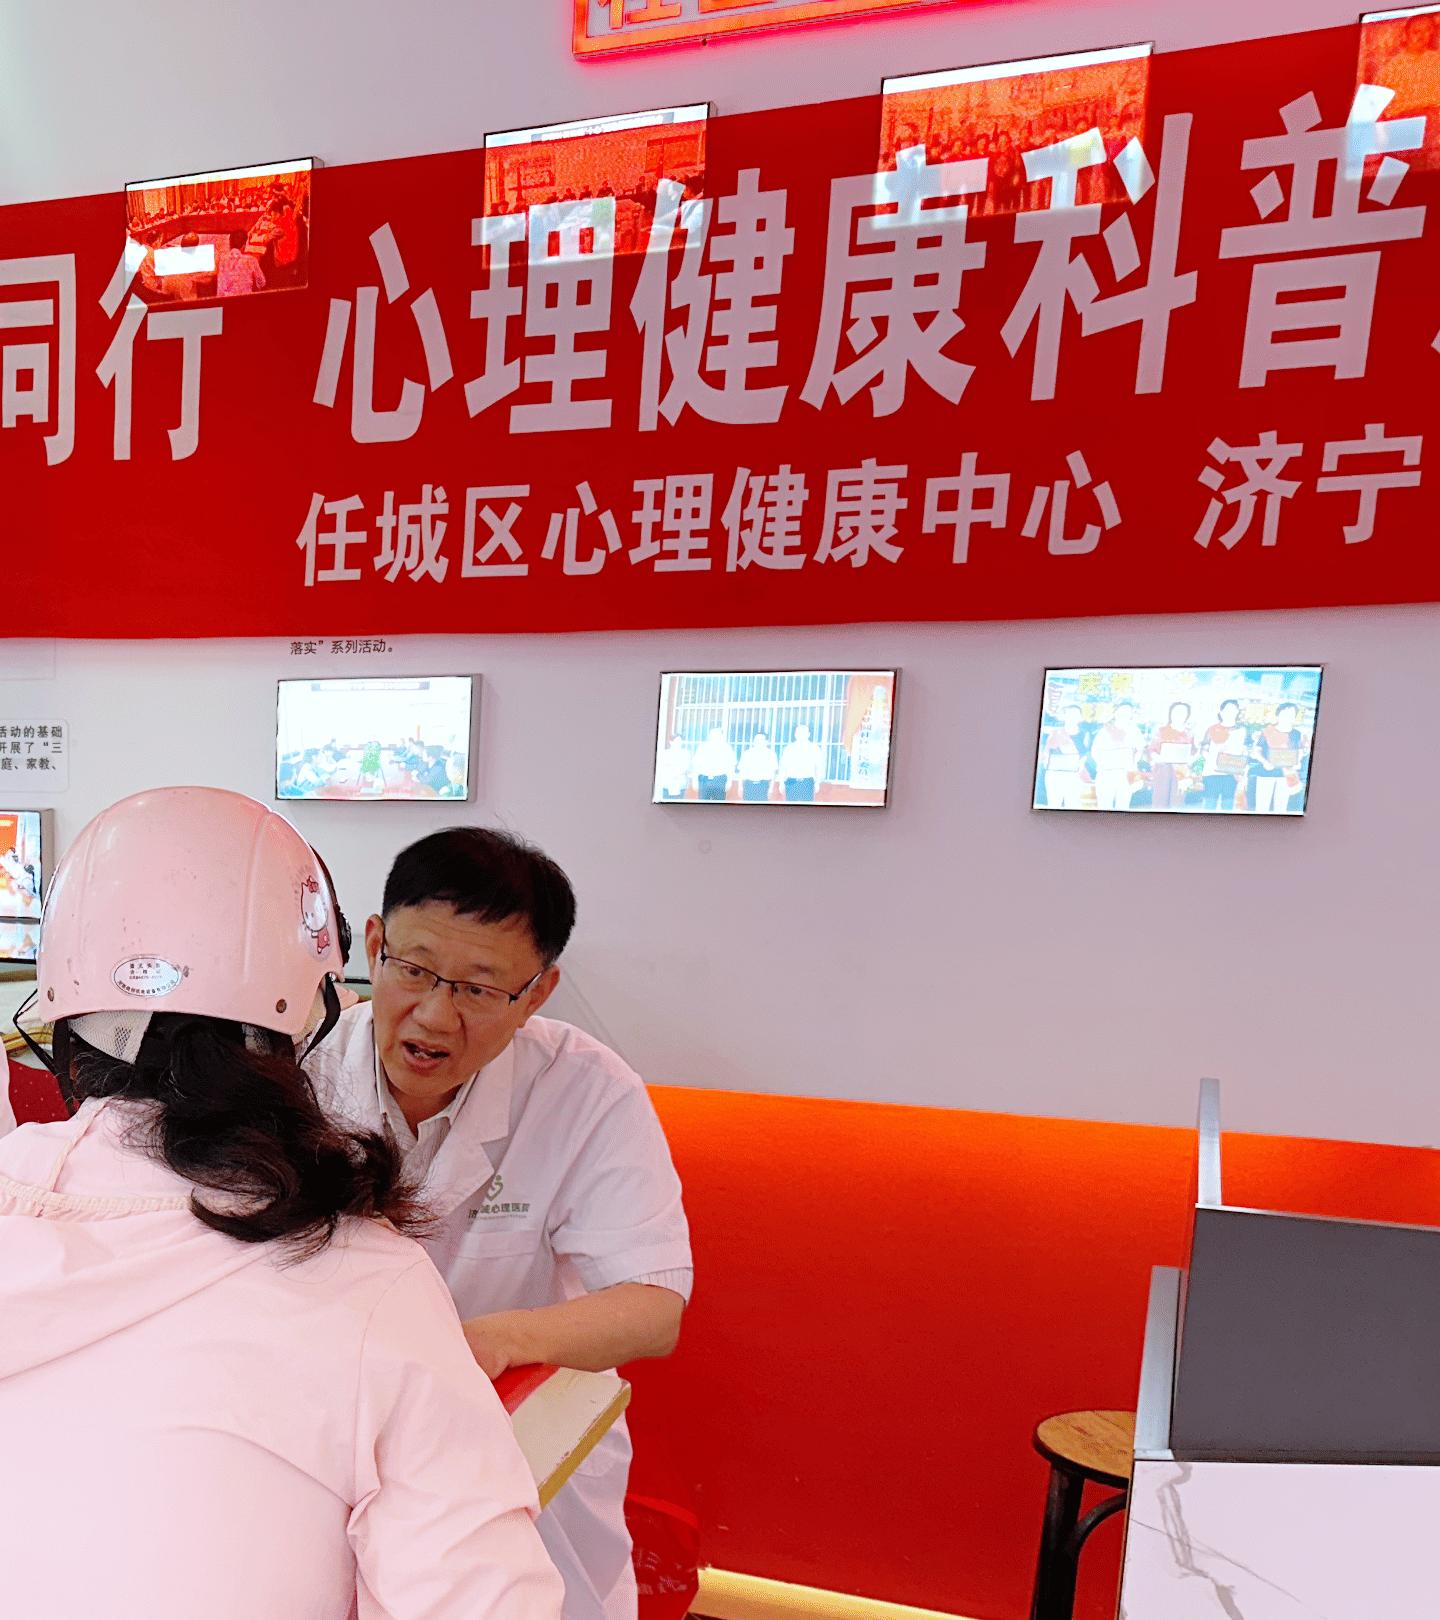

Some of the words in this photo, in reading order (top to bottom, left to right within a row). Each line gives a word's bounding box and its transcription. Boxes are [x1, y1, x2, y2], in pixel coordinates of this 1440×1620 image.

[313, 83, 1440, 443] 心理健康科普
[296, 450, 1121, 589] 任城区心理健康中心
[1194, 424, 1421, 550] 济宁
[290, 639, 393, 655] 落实”系列活动。
